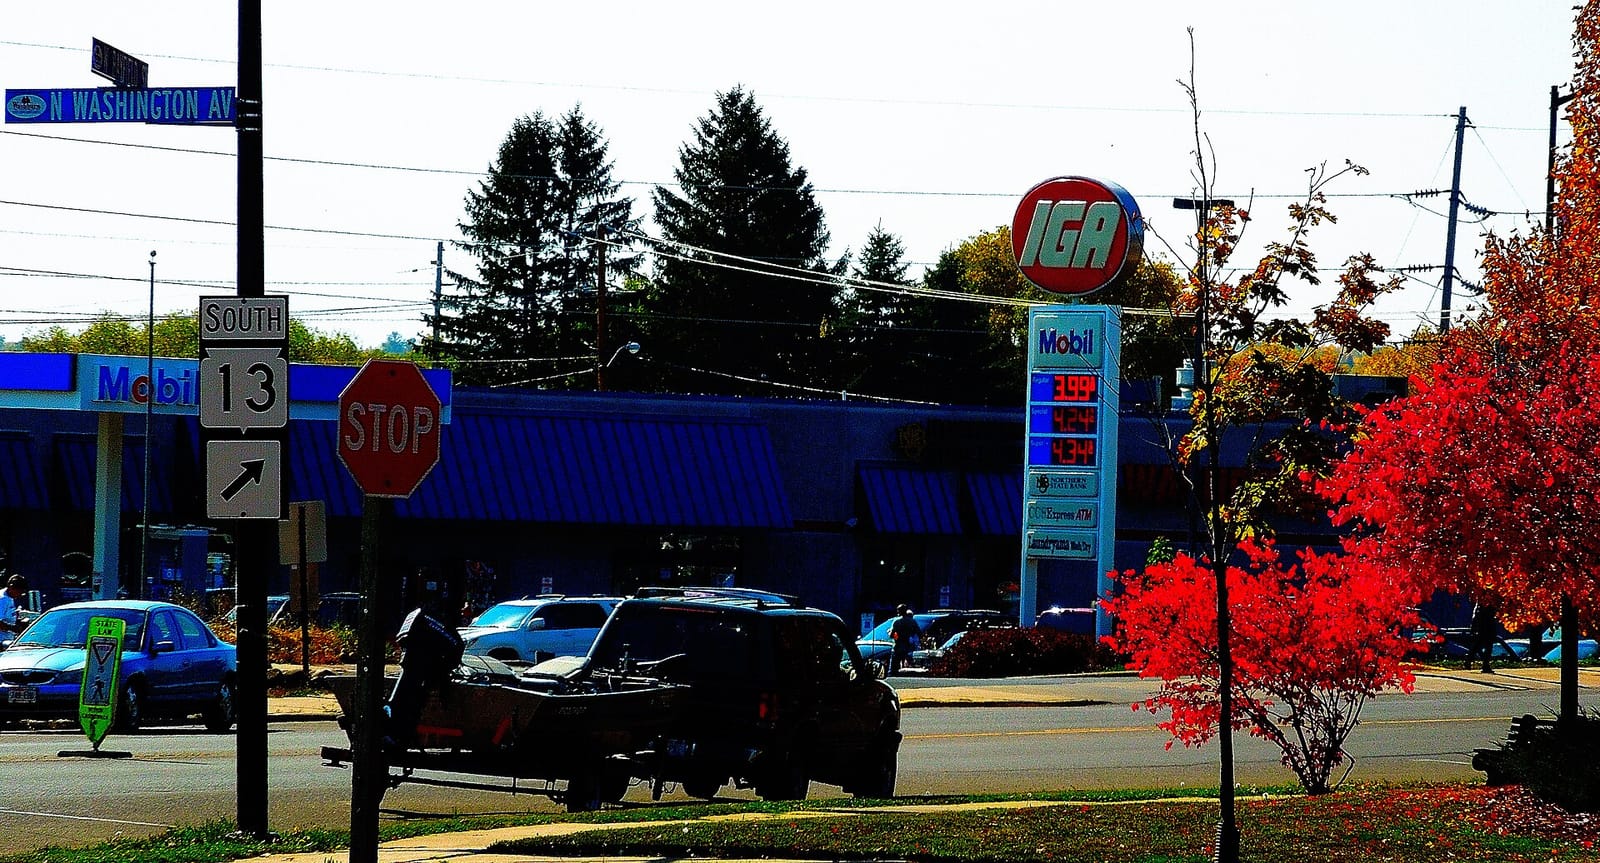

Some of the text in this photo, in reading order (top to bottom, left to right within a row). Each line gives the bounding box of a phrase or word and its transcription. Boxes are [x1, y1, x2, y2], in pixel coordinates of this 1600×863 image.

[50, 89, 233, 121] N WASHINGTON AV
[1019, 199, 1122, 269] IGA
[205, 303, 282, 333] SOUTH
[1039, 327, 1094, 355] Mobil
[97, 364, 200, 406] Mobil
[218, 361, 277, 414] 13
[1031, 407, 1049, 416] Special
[344, 402, 434, 454] STOP
[1076, 508, 1092, 520] ATM
[96, 620, 118, 628] STATE
[98, 627, 113, 636] LAW
